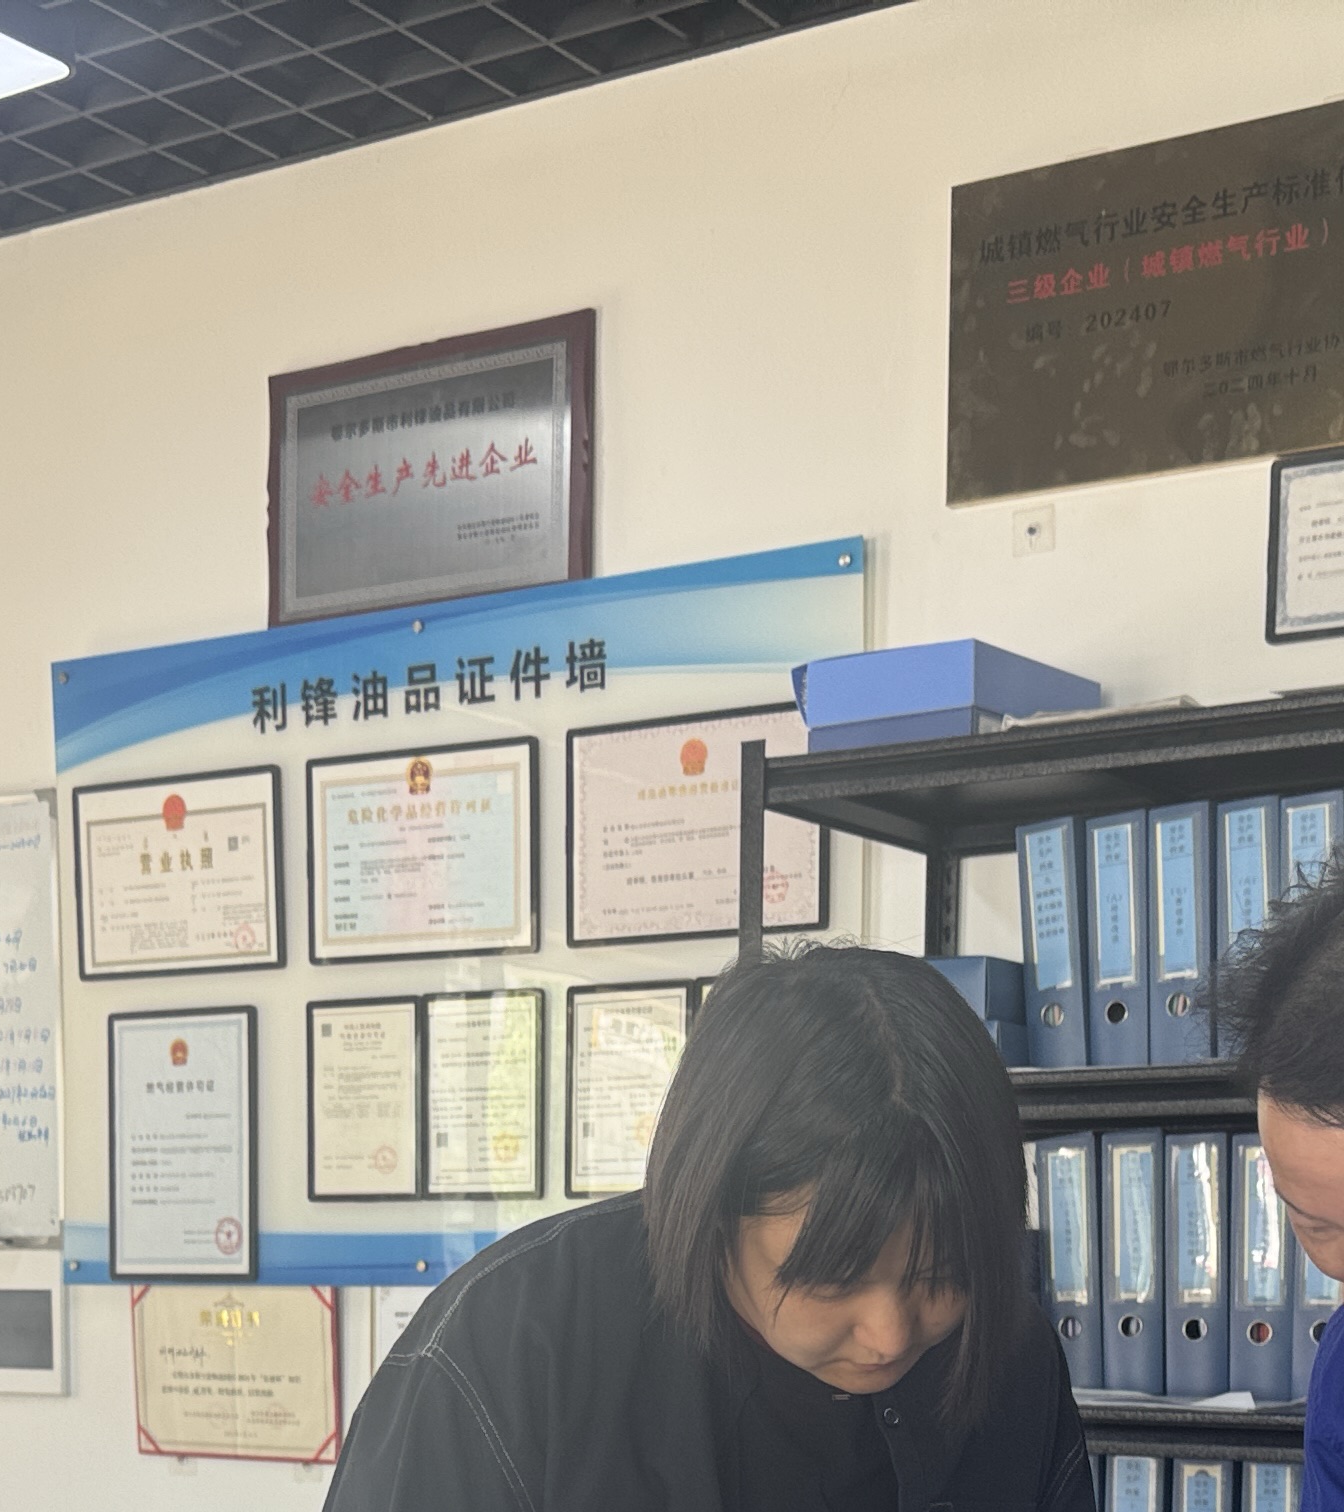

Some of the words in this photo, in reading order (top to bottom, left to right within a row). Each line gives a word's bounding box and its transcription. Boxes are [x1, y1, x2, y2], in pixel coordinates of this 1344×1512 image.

[309, 437, 538, 508] 安全生产先进企业
[251, 638, 610, 733] 利锋油品证件墙
